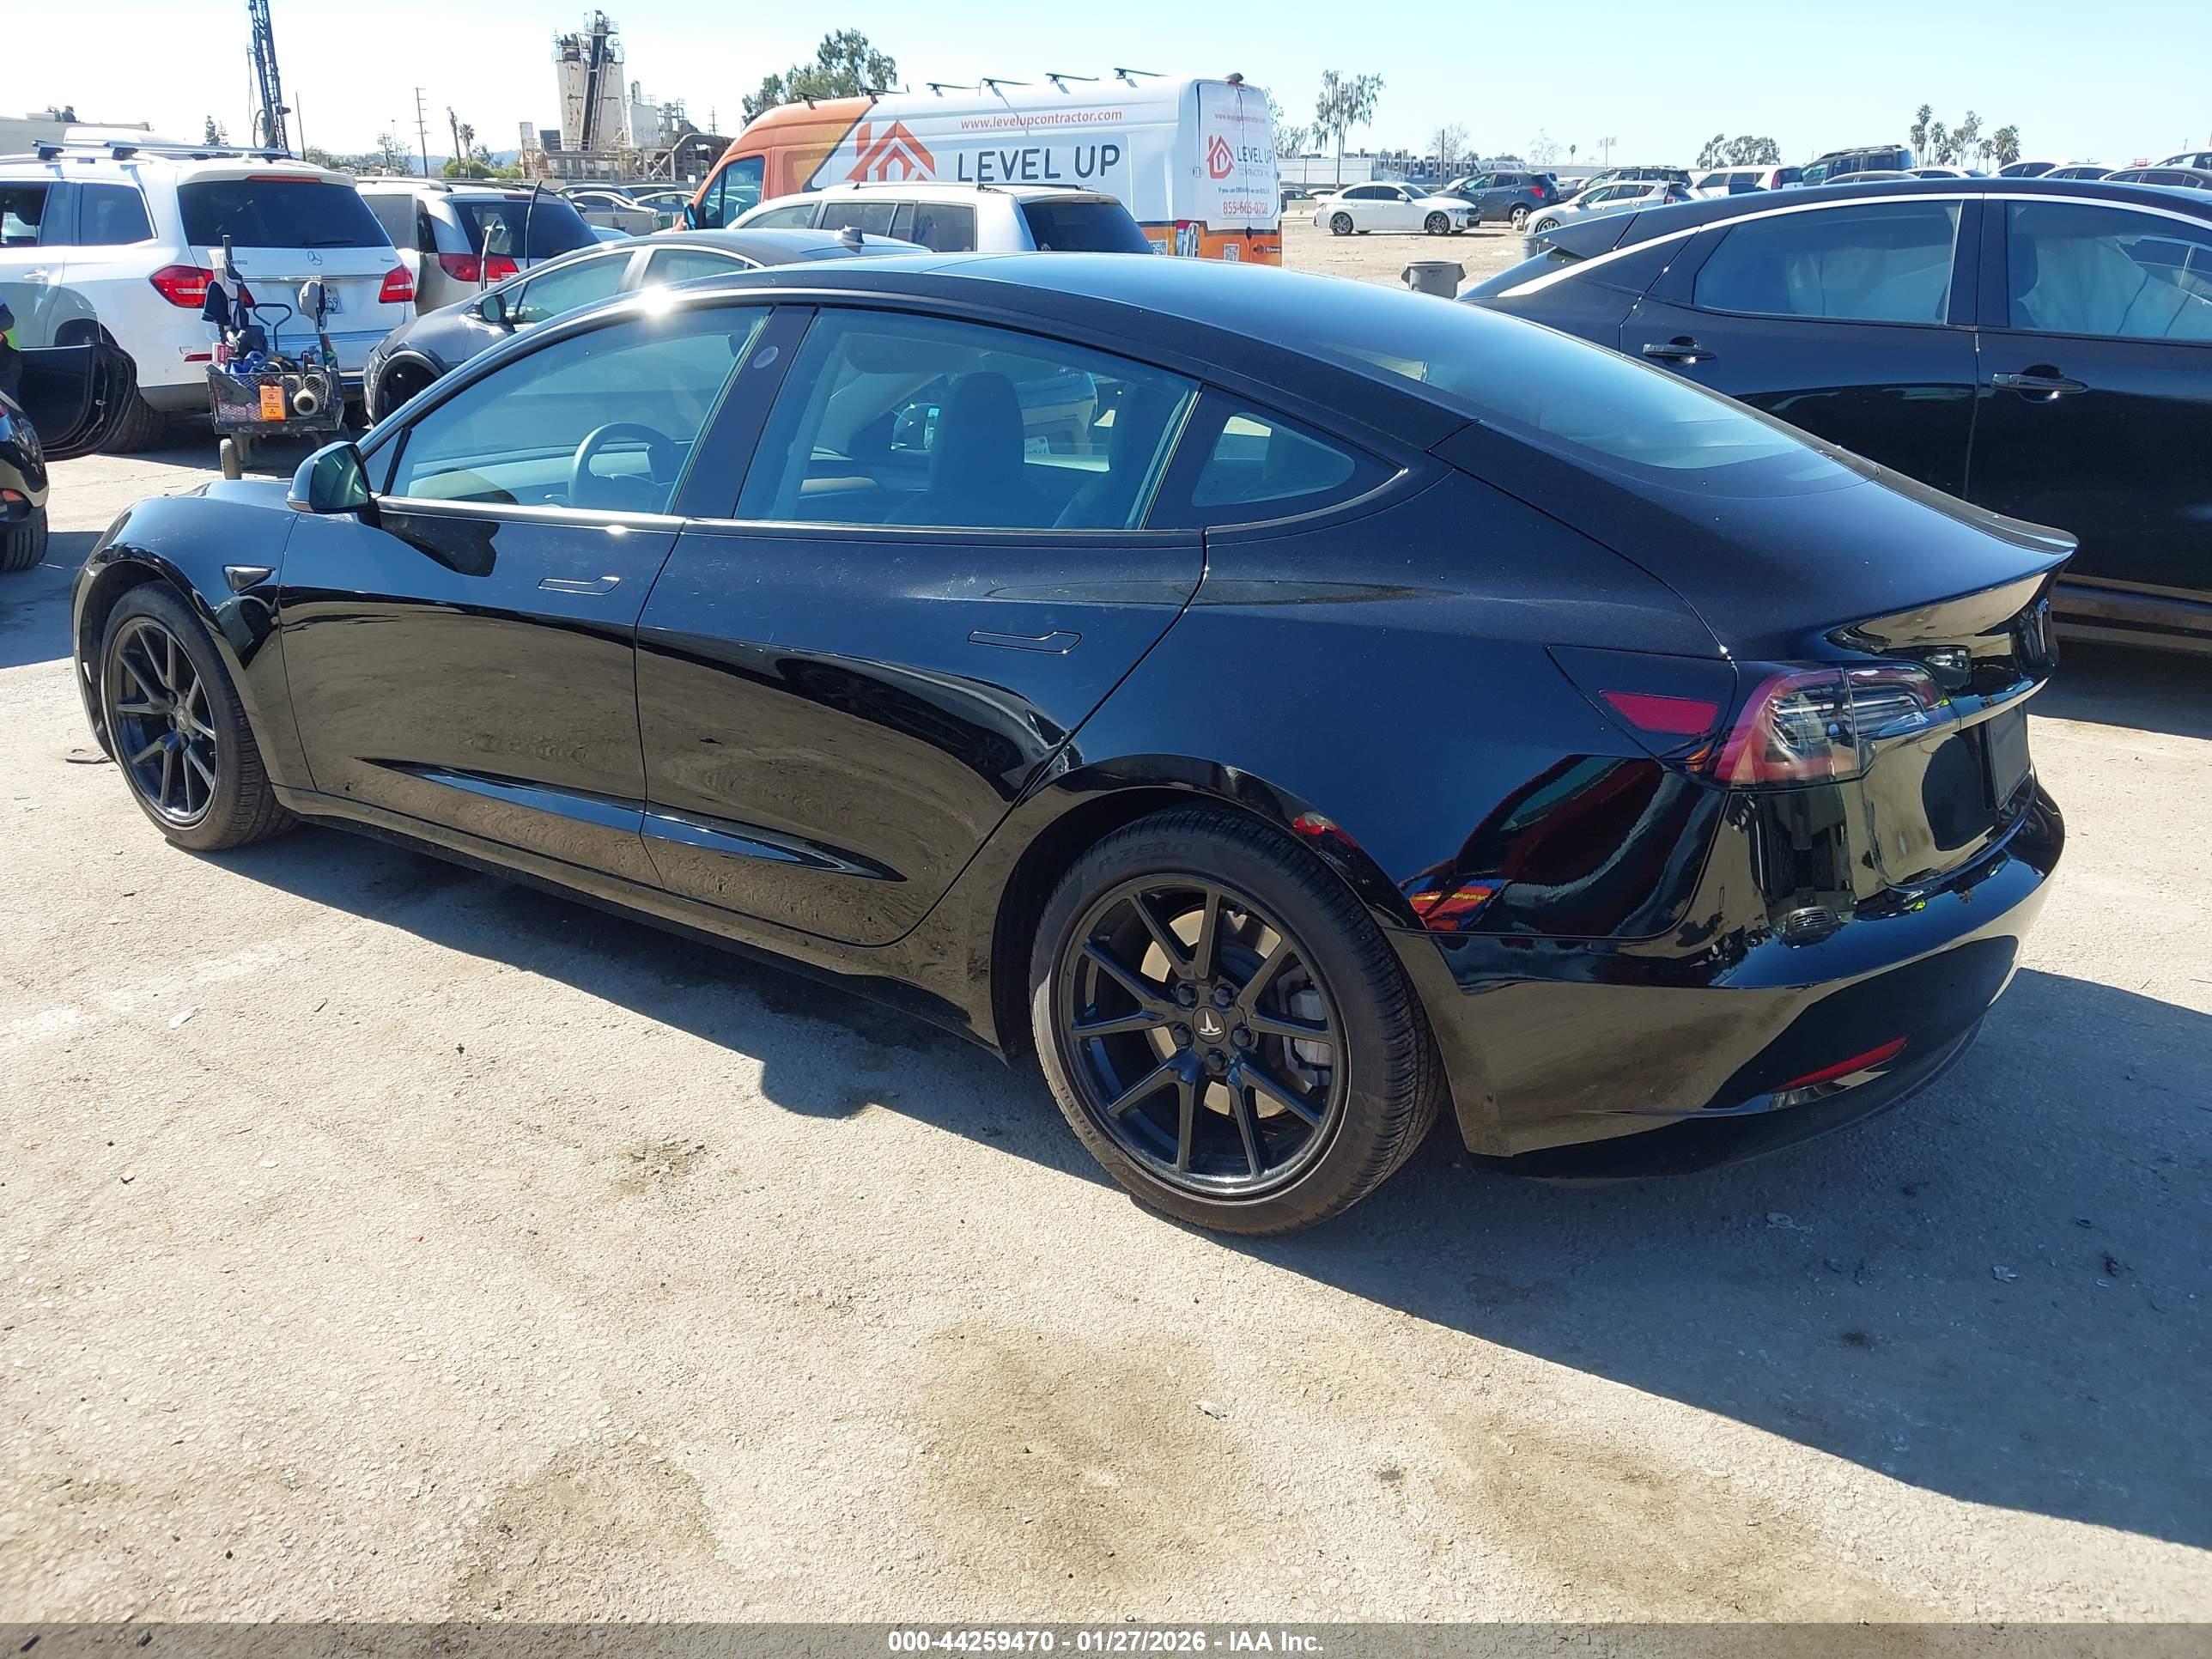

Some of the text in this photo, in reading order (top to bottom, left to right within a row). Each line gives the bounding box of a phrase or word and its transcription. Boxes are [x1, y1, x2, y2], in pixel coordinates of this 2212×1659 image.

[960, 110, 1122, 130] www.levelupcontractor.com
[957, 144, 1121, 182] LEVEL UP
[1237, 146, 1273, 164] LEVEL UP
